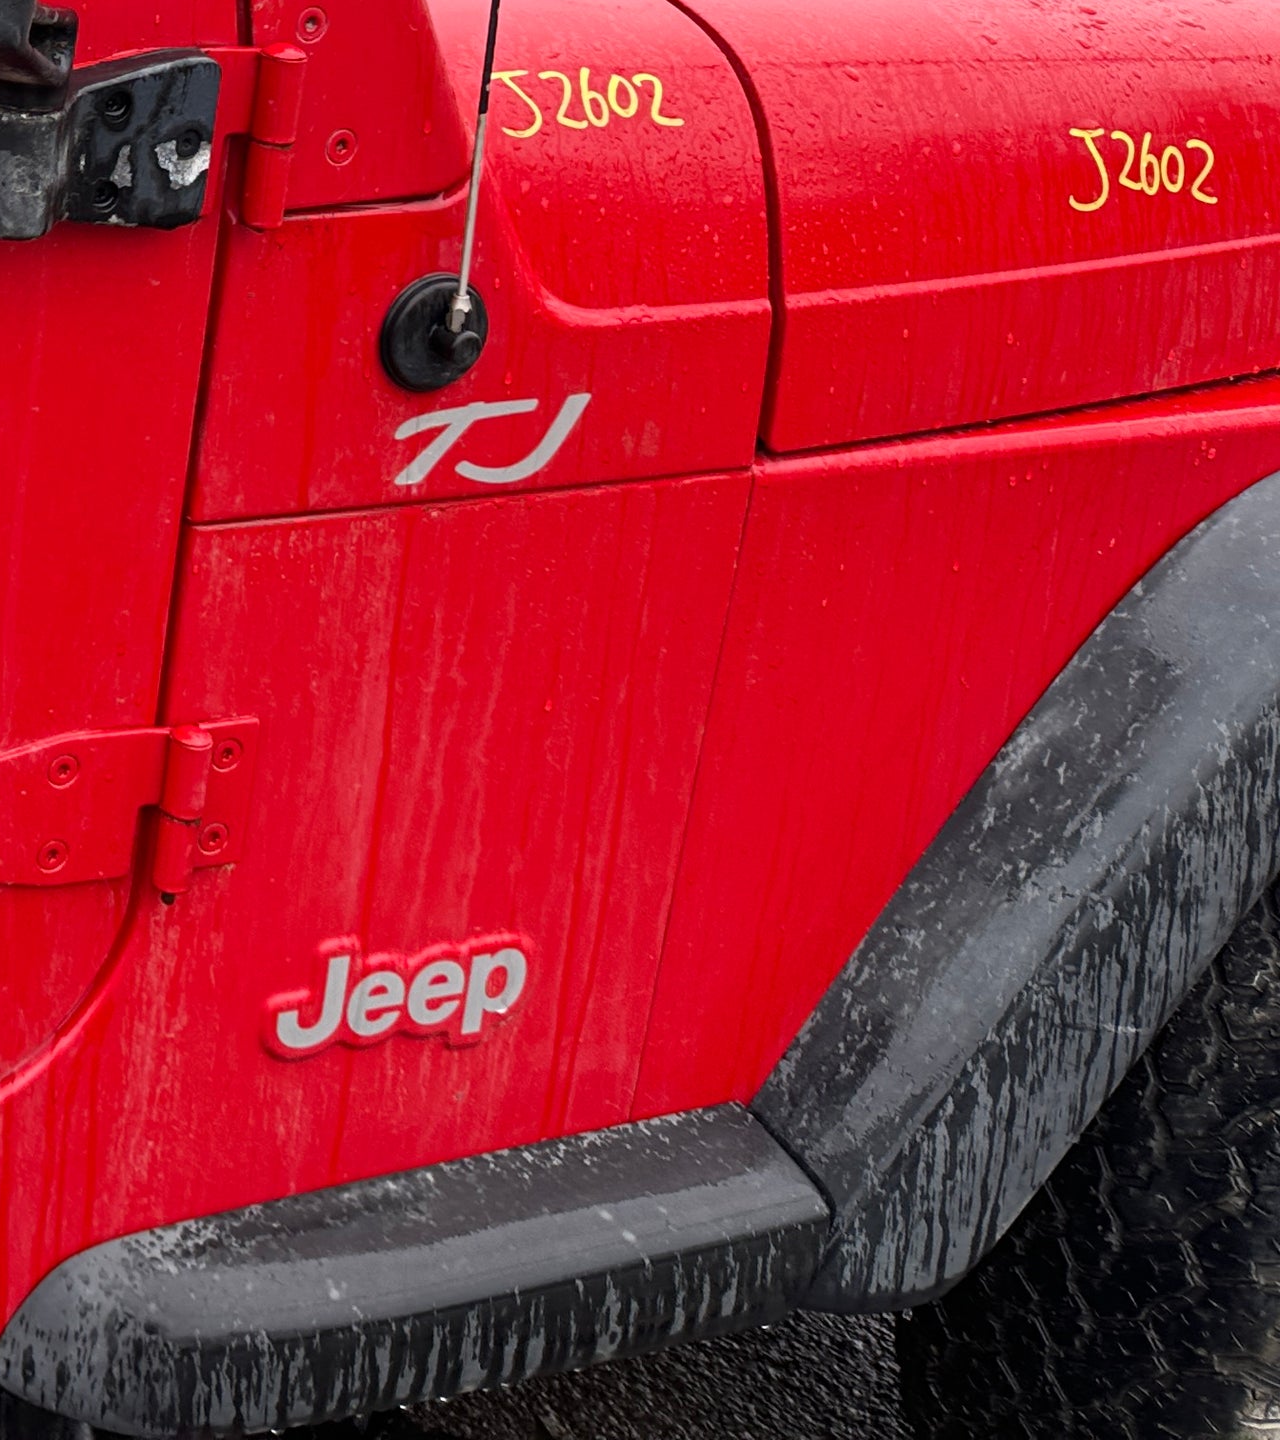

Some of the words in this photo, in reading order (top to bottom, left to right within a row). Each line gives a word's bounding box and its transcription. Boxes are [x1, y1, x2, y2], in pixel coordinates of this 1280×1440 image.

[489, 67, 684, 137] J2602
[1069, 128, 1218, 212] J2602
[394, 392, 591, 486] TJ
[276, 947, 527, 1049] Jeep
